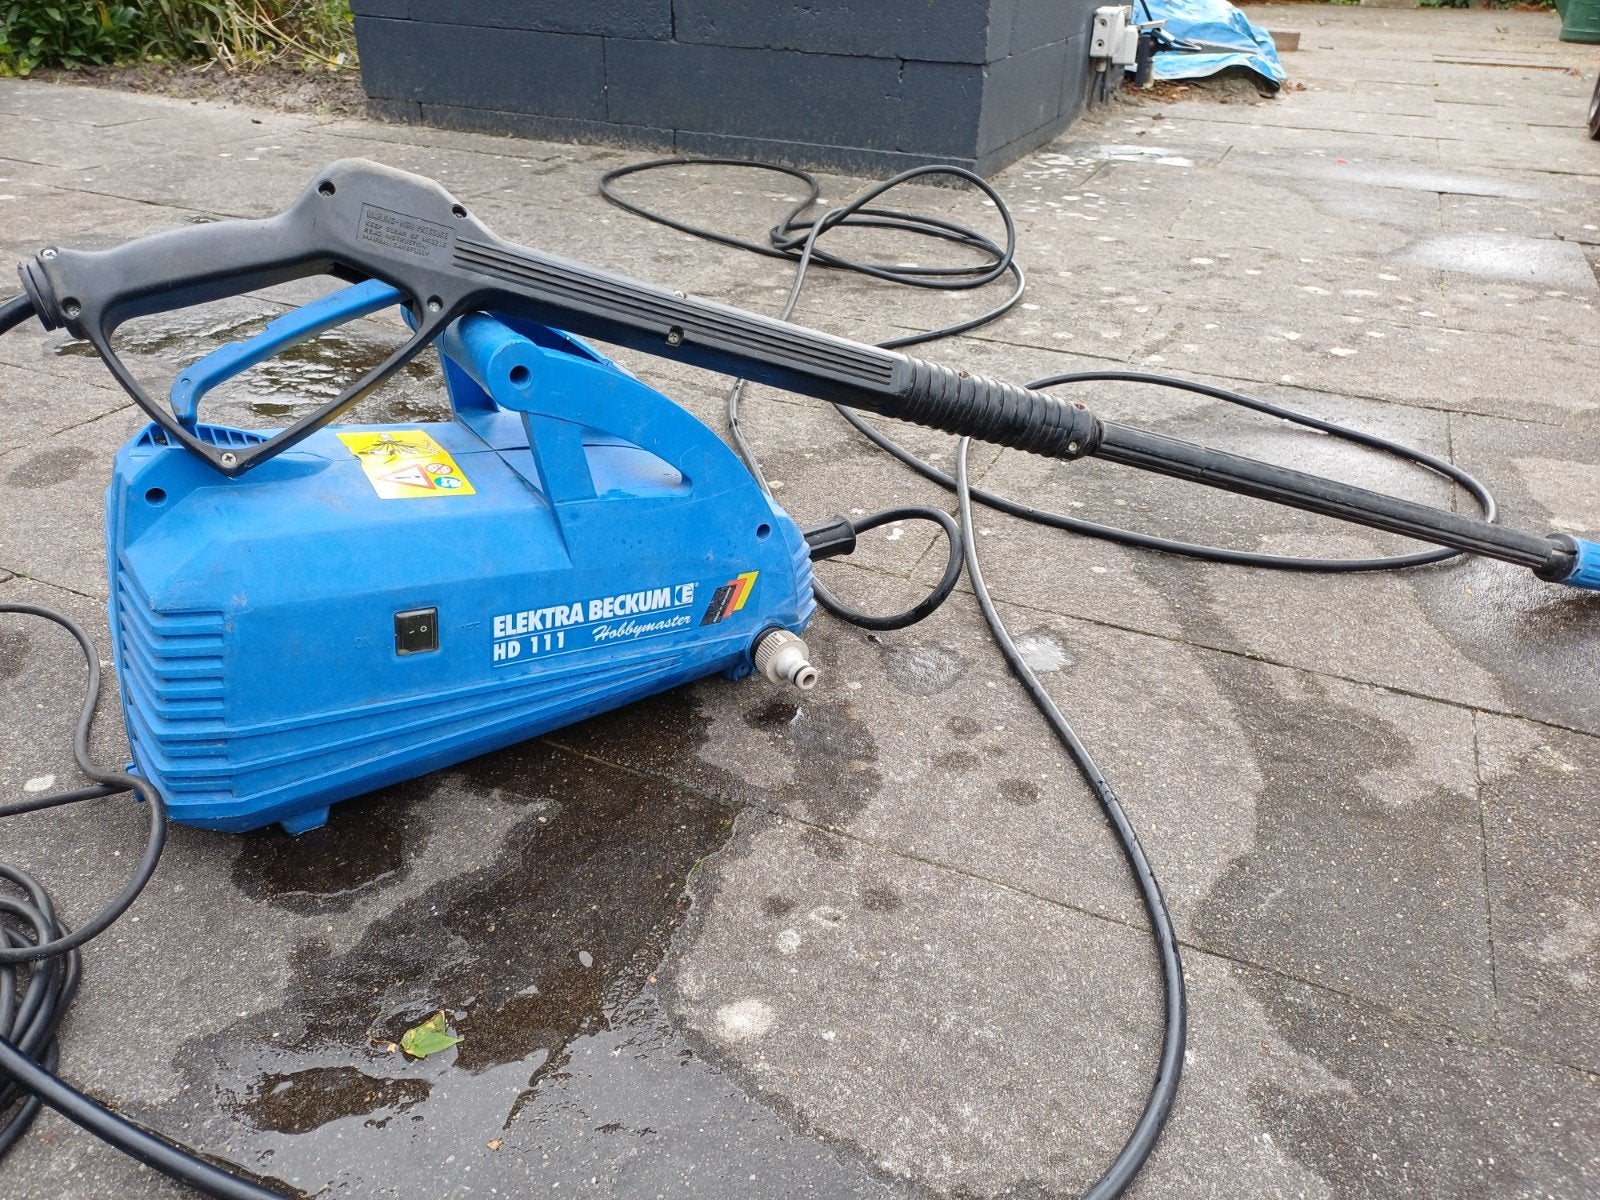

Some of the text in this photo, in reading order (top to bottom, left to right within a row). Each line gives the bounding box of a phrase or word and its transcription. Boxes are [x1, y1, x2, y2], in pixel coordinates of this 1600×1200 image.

[363, 227, 381, 237] READ
[386, 226, 407, 237] CLEAR
[422, 237, 447, 248] NOZZLE
[493, 602, 584, 638] ELEKTRA
[588, 586, 671, 621] BECKUM
[493, 614, 692, 662] HD 111 Hobbymaster
